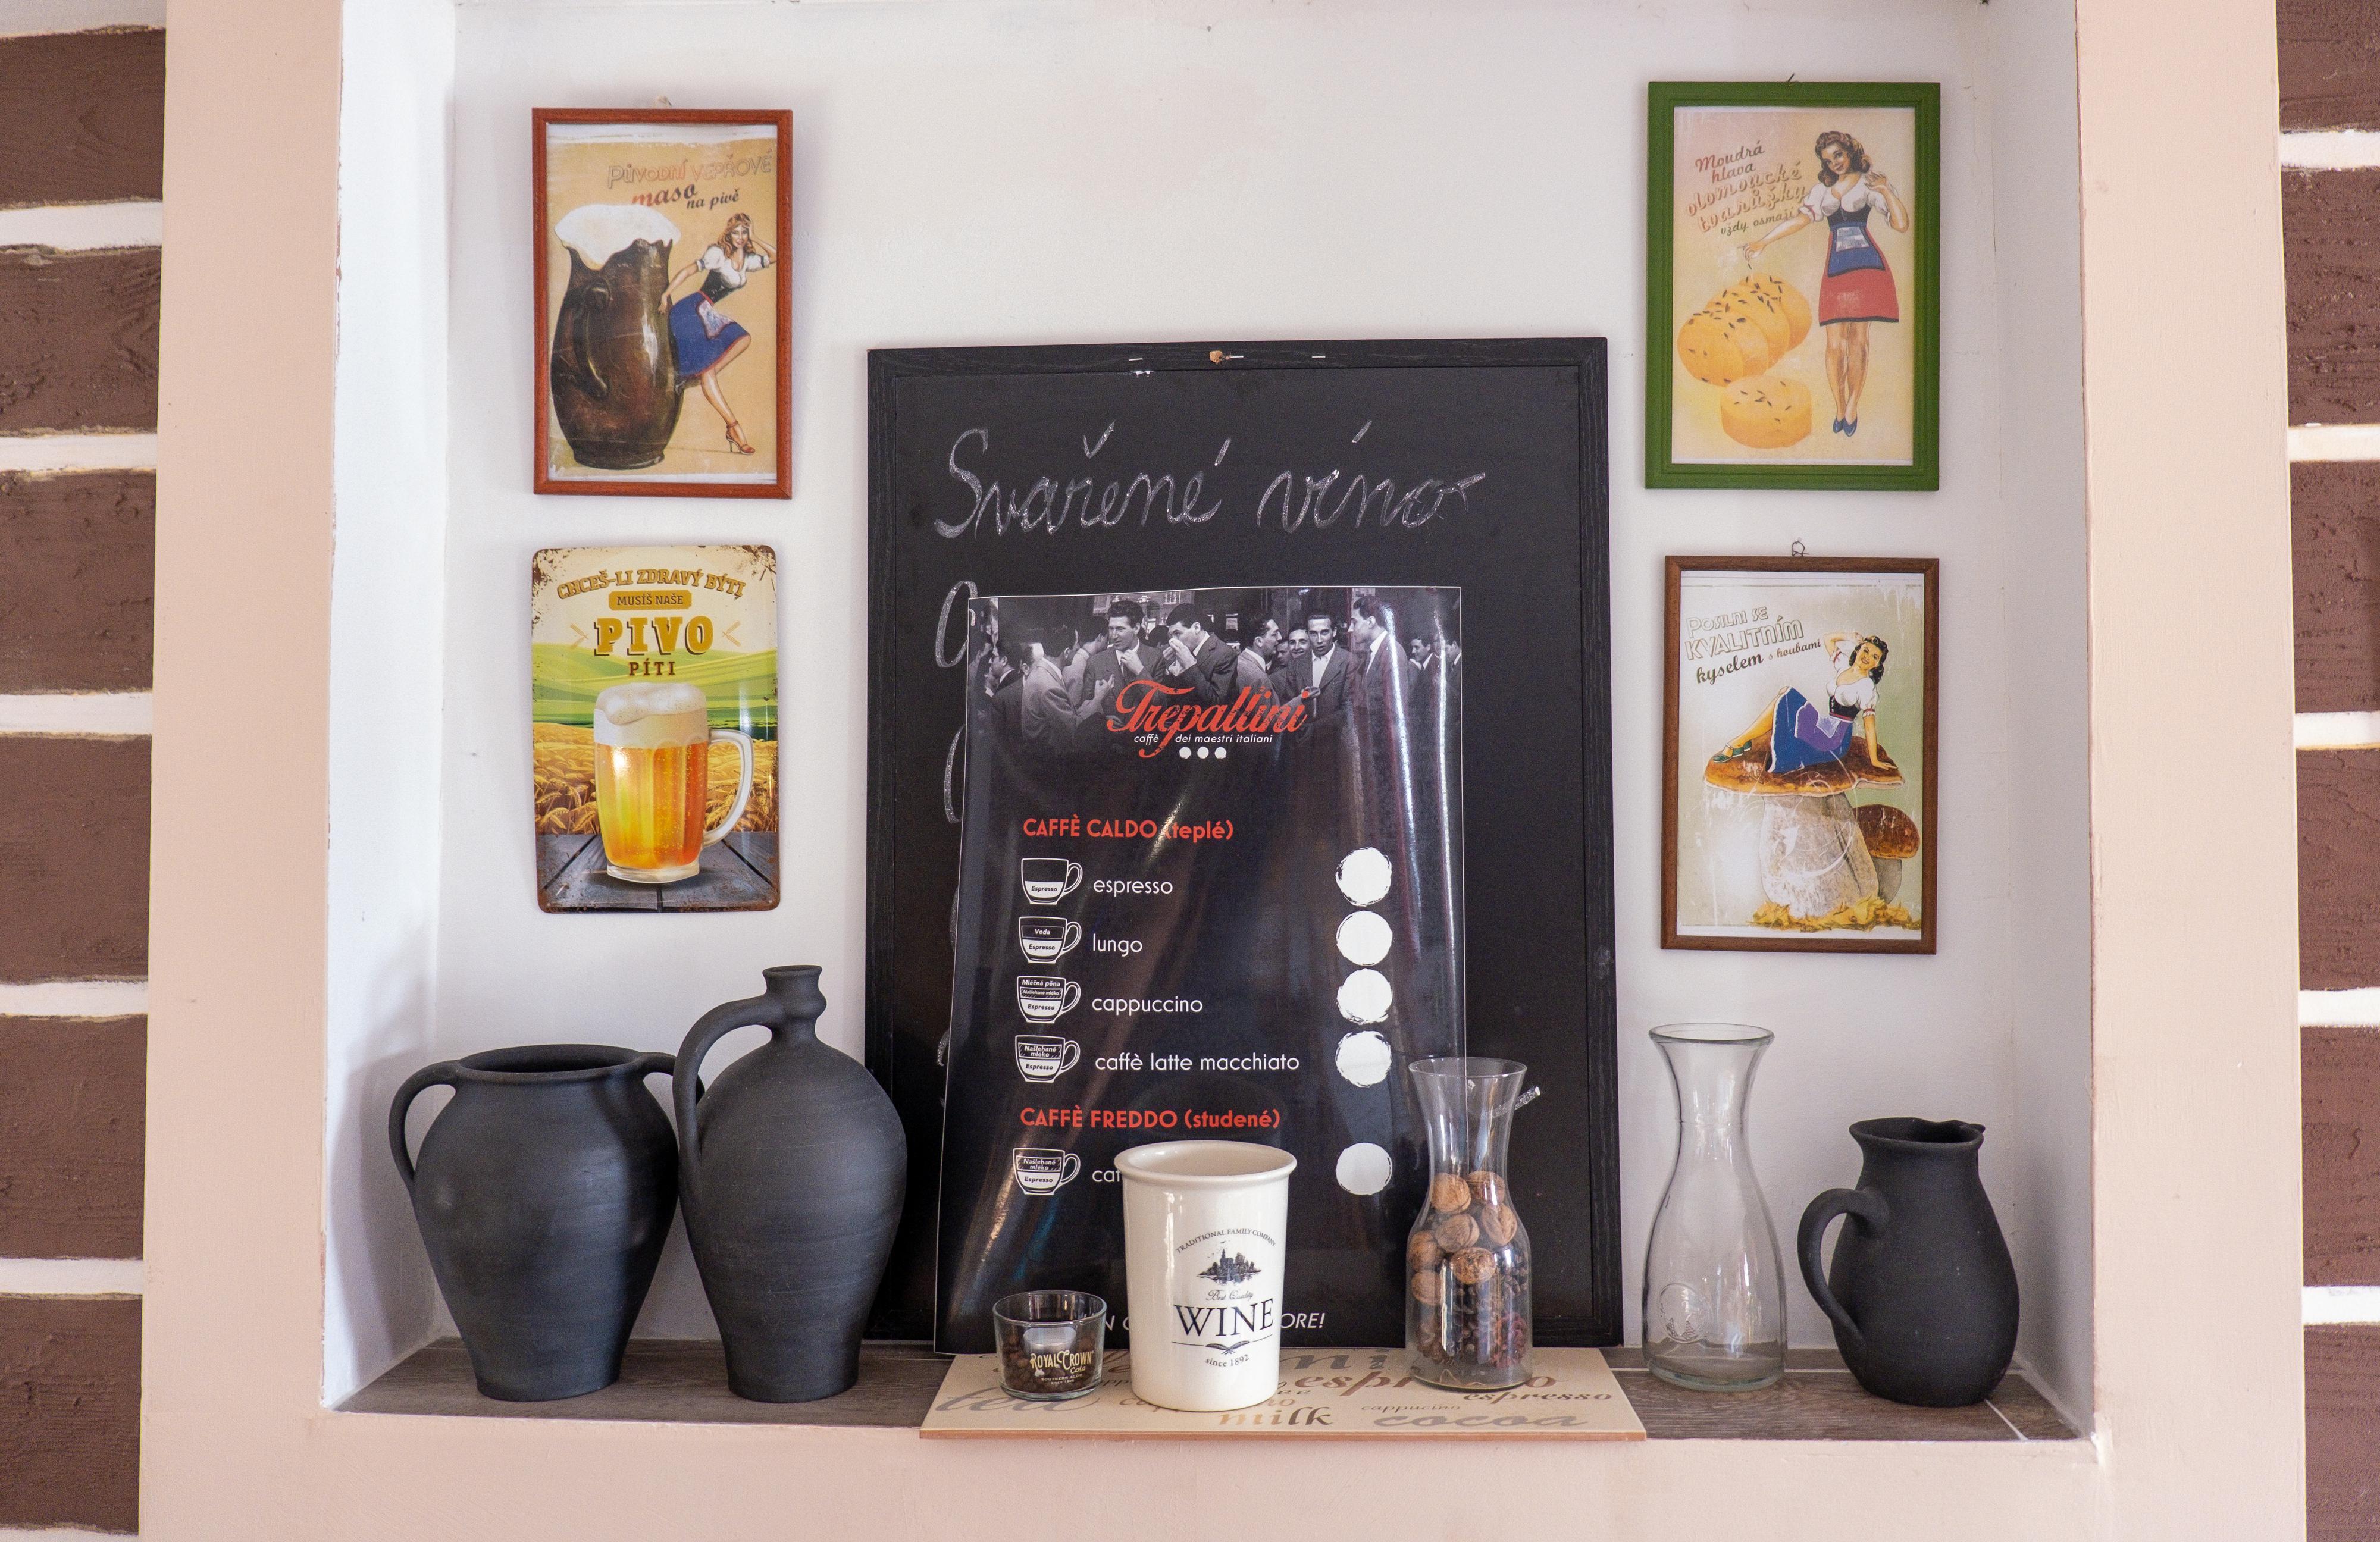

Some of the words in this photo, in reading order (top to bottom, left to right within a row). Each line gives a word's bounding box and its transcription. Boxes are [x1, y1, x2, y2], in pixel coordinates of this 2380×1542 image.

[1695, 139, 1765, 173] Moudrá
[1712, 162, 1756, 184] hlava
[631, 184, 698, 207] maso
[687, 199, 704, 209] na
[709, 189, 740, 210] pivě
[1720, 220, 1749, 236] vždy
[933, 421, 1231, 540] Svařené
[1257, 419, 1486, 534] víno
[557, 569, 634, 600] CHCEŠ-LI
[637, 569, 704, 587] ZDRAVÝ
[705, 572, 746, 598] BÝTI
[616, 593, 653, 606] MUSÍŠ
[654, 592, 684, 605] NAŠE
[594, 615, 713, 656] PIVO
[629, 658, 675, 676] PÍTI
[1696, 653, 1764, 685] kyselem
[1776, 639, 1822, 658] houbami
[1106, 679, 1310, 759] Trepallini
[1133, 734, 1159, 744] caffè
[1175, 733, 1191, 743] dei
[1194, 734, 1233, 743] maestri
[1236, 734, 1273, 744] italiani
[1023, 814, 1081, 838] CAFFÈ
[1086, 819, 1157, 838] CALDO
[1166, 820, 1233, 844] (teplé)
[1092, 879, 1173, 897] espresso
[1092, 934, 1143, 957] lungo
[1091, 996, 1203, 1016] cappuccino
[1095, 1052, 1143, 1071] caffè
[1150, 1052, 1193, 1071] latte
[1200, 1052, 1300, 1071] macchiato
[1020, 1104, 1082, 1128] CAFFÈ
[1091, 1109, 1178, 1128] FREDDO
[1185, 1108, 1280, 1129] (studené)
[1175, 1230, 1226, 1253] TRADITIONAL
[1252, 1230, 1276, 1247] COMPANY
[1173, 1298, 1274, 1336] WINE
[1280, 1312, 1326, 1328] ORE!
[1030, 1353, 1059, 1369] ROYAL
[1057, 1350, 1094, 1371] CROWN
[1205, 1357, 1227, 1367] since
[1230, 1354, 1250, 1366] 1892
[1463, 1391, 1612, 1404] espresso
[1217, 1406, 1333, 1426] milk
[1373, 1415, 1587, 1427] cocoa
